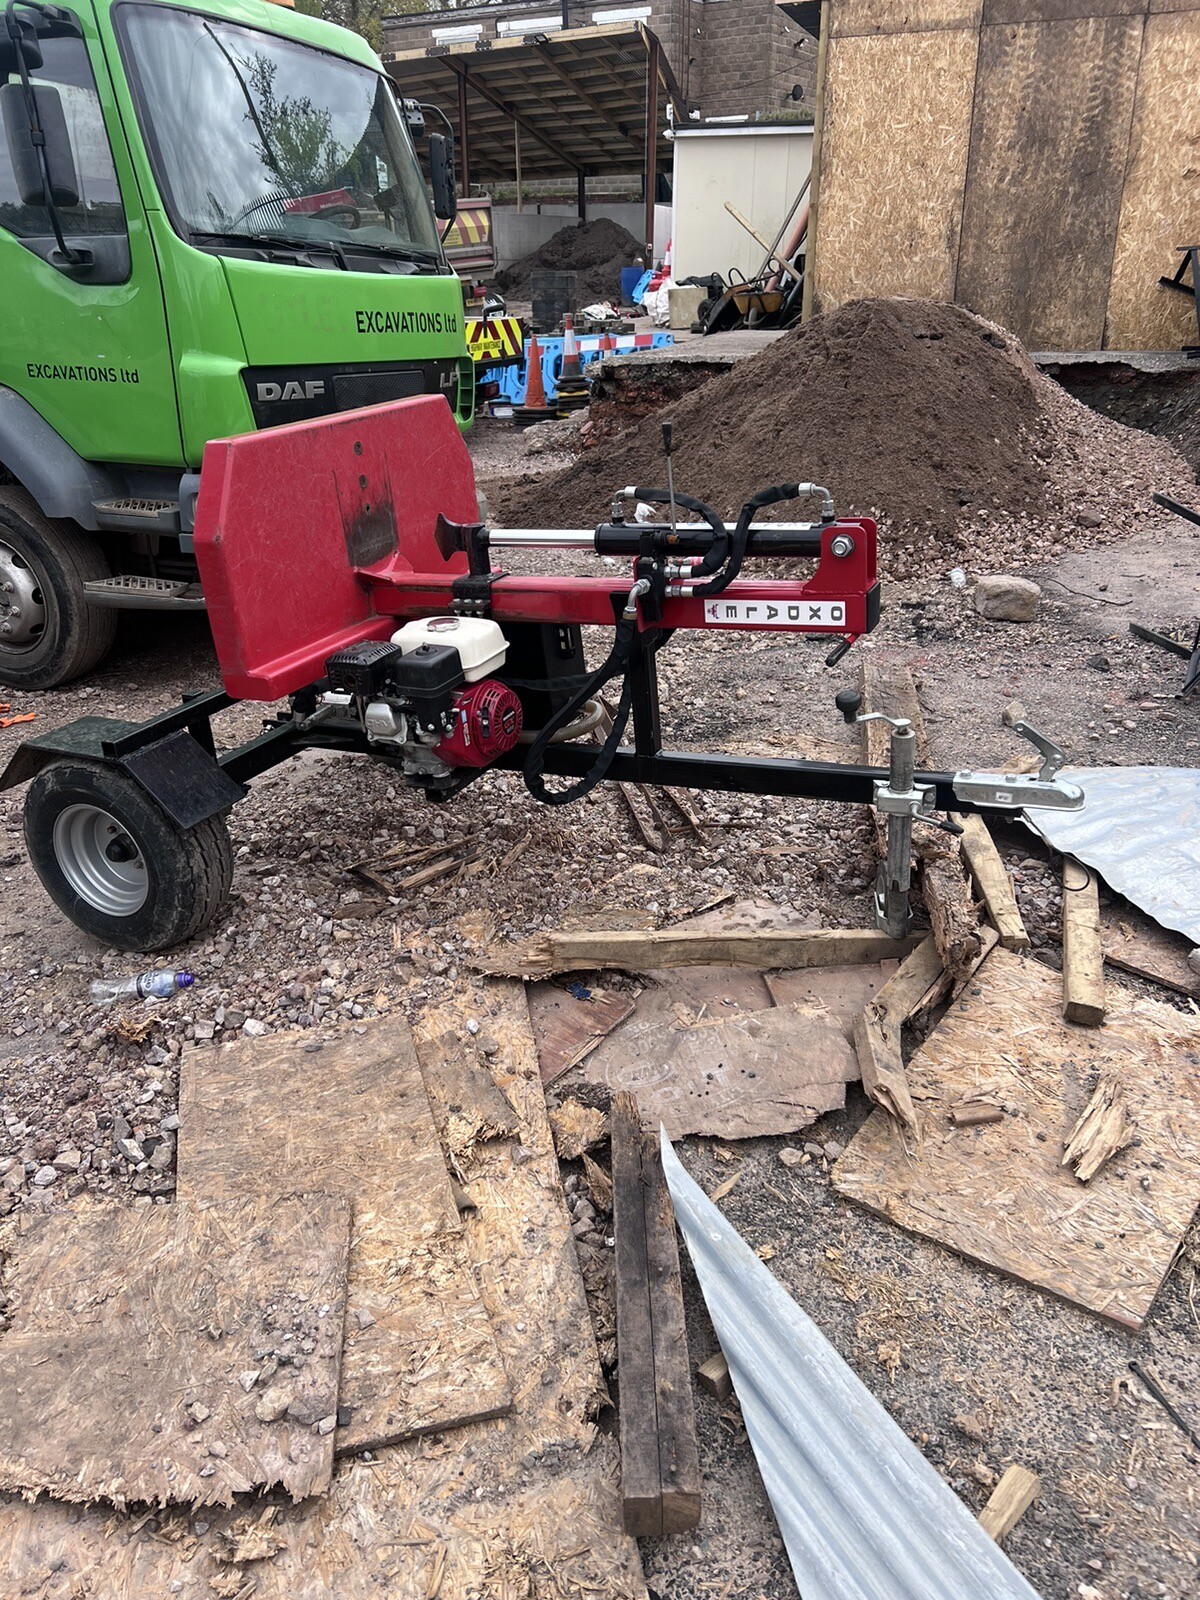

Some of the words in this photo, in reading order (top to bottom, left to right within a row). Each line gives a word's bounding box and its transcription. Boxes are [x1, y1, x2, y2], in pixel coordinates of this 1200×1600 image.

[355, 310, 442, 333] EXCAVATIONS
[443, 313, 457, 333] ltd
[27, 363, 118, 382] EXCAVATIONS
[120, 368, 139, 383] ltd
[256, 380, 325, 401] DAF
[725, 604, 843, 622] OXDALE
